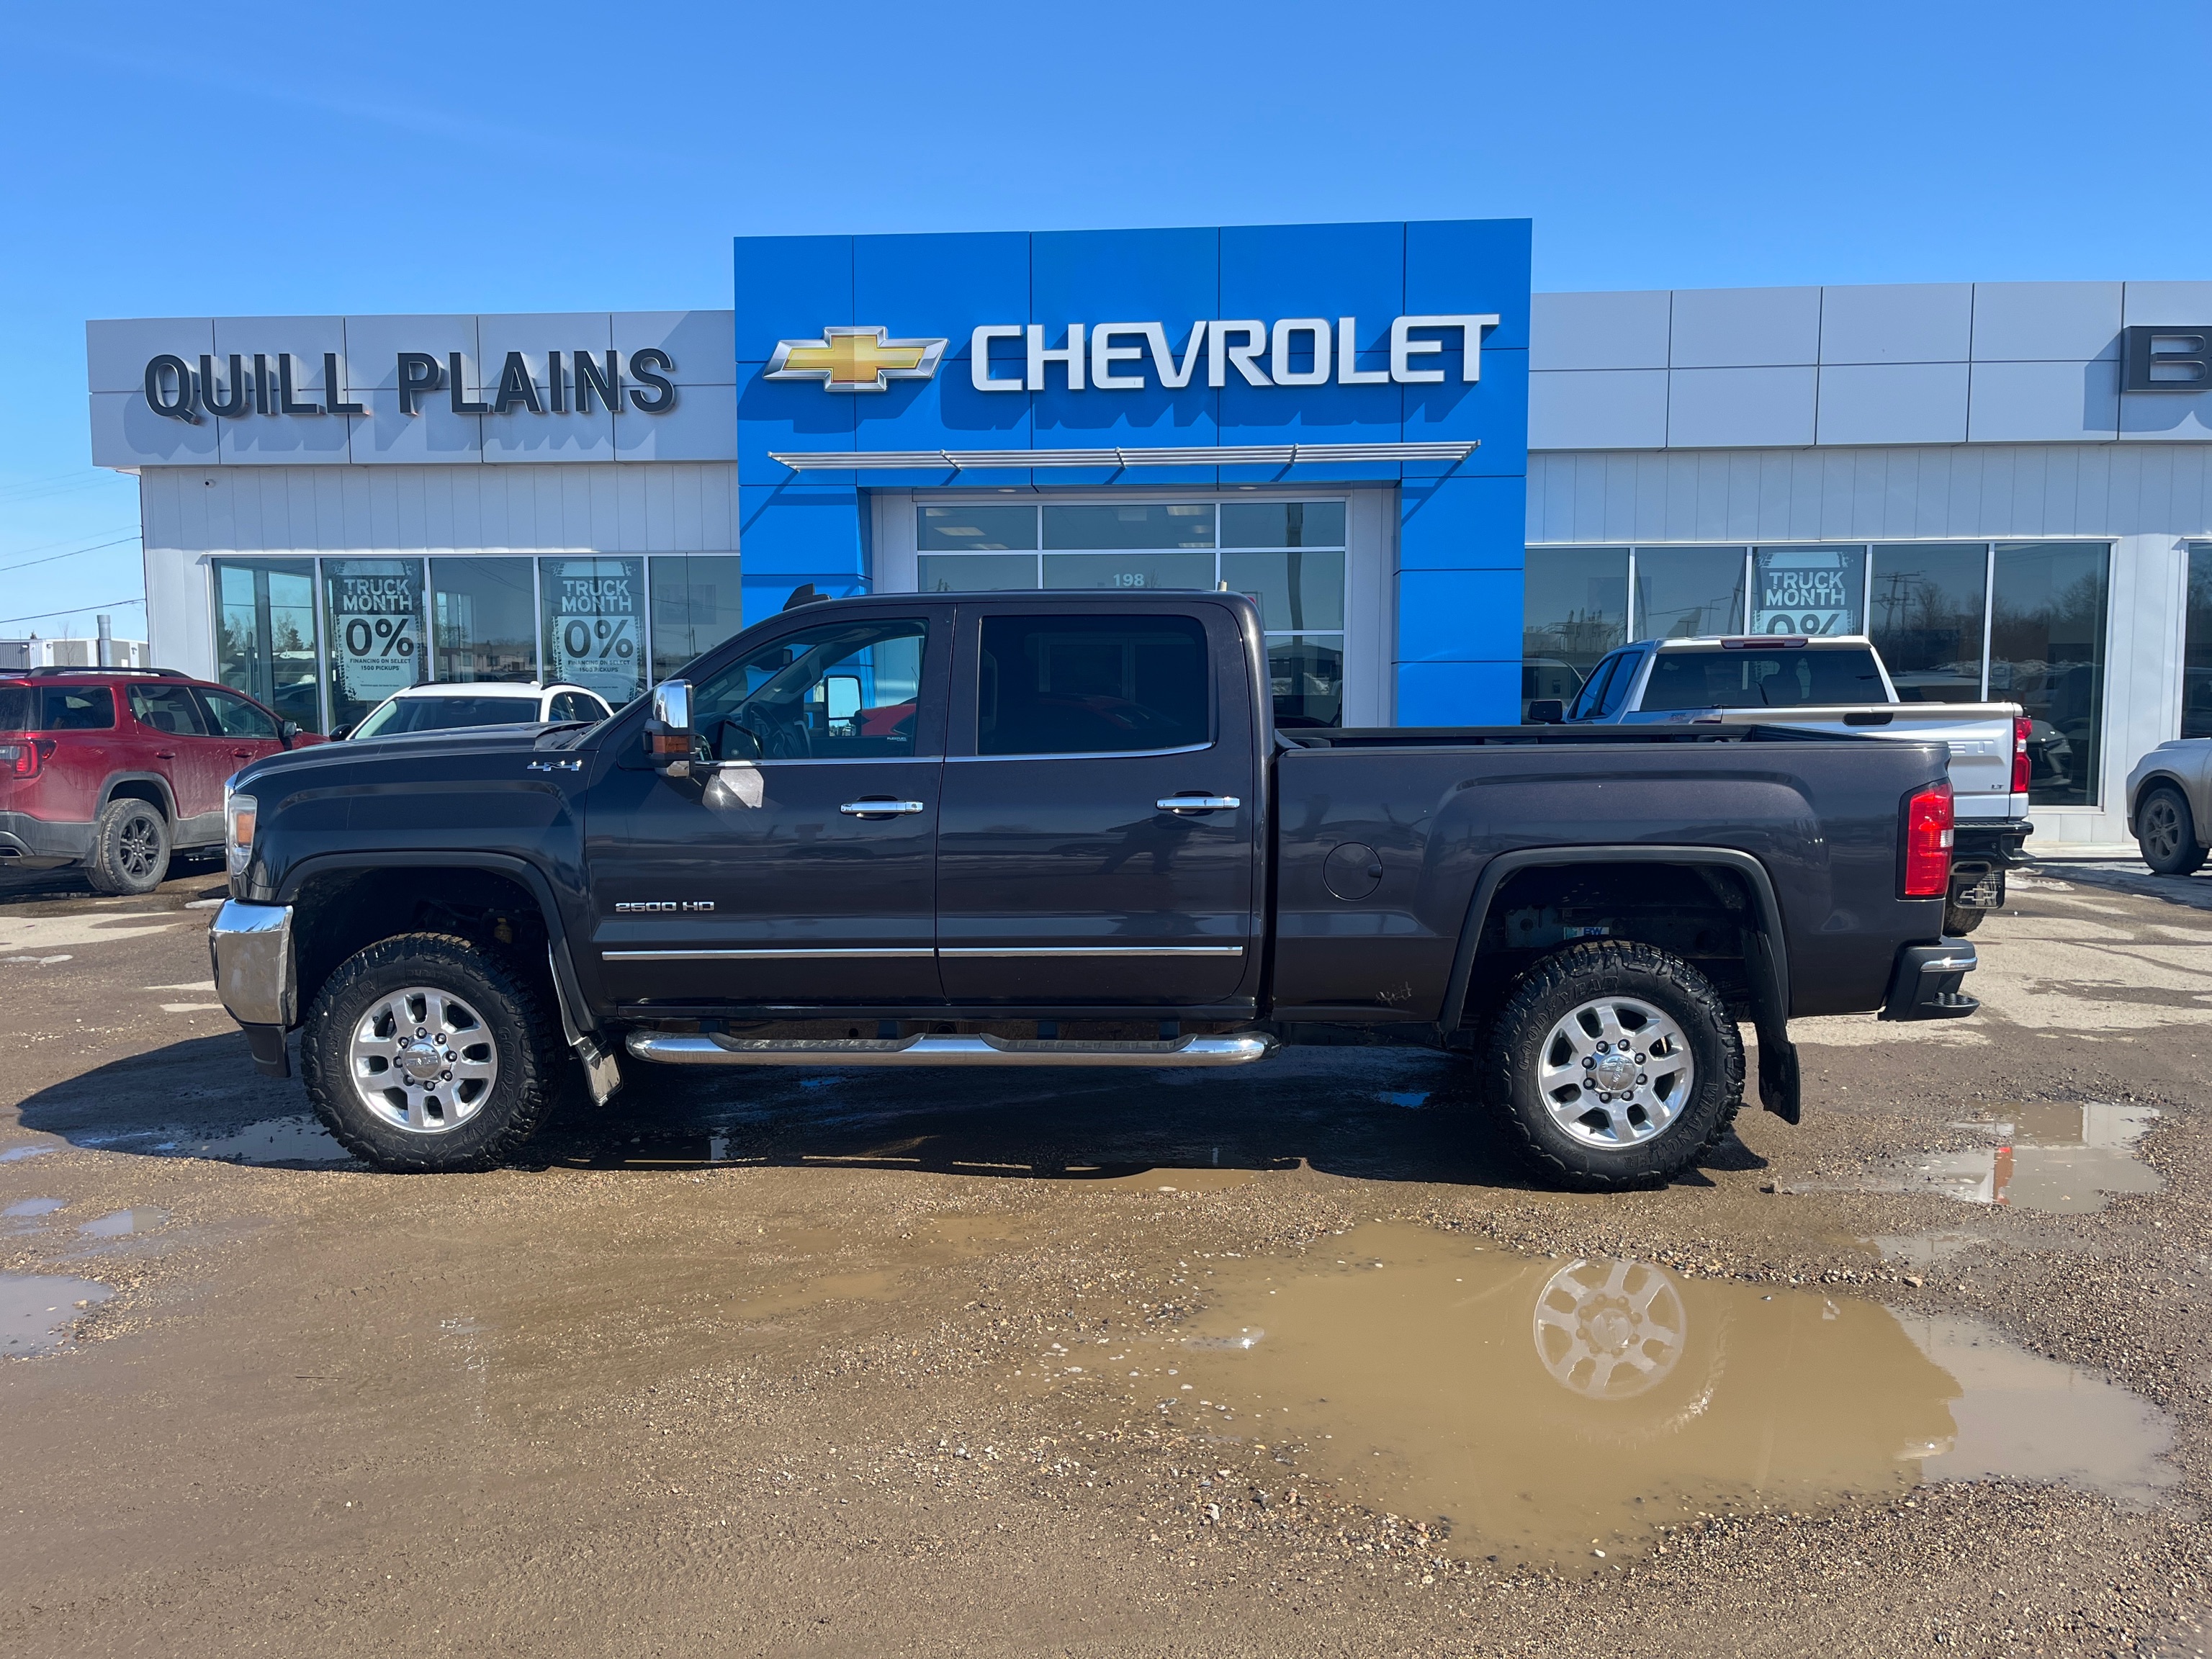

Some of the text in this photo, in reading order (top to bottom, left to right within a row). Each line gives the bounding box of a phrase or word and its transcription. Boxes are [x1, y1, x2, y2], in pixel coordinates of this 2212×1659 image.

[971, 313, 1501, 392] CHEVROLET
[144, 348, 677, 426] QUILL PLAINS
[343, 579, 410, 595] TRUCK
[562, 580, 630, 596] TRUCK
[1113, 573, 1144, 587] 198
[1768, 571, 1844, 589] TRUCK
[343, 595, 413, 611] MONTH
[562, 595, 632, 613] MONTH
[1766, 588, 1846, 606] MONTH
[346, 618, 414, 657] 0%
[564, 619, 634, 659] 0%
[615, 901, 715, 912] 2500 HD
